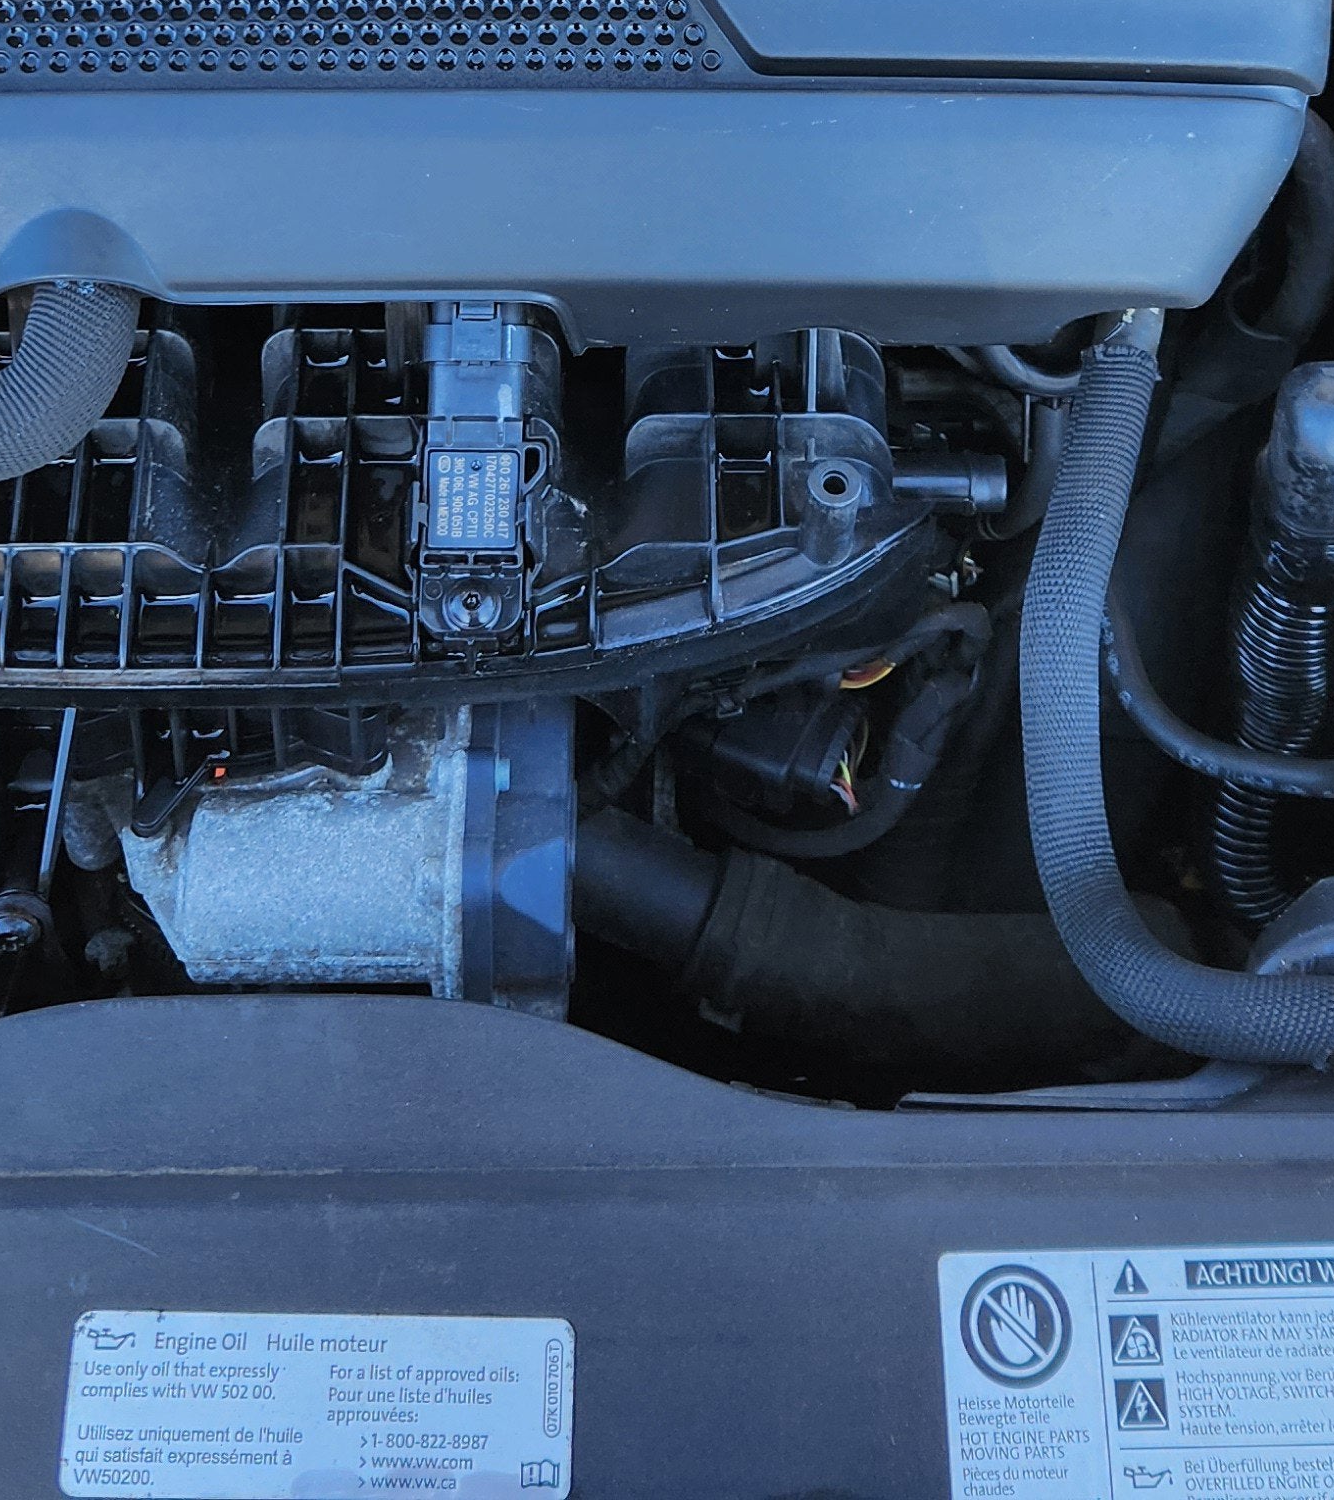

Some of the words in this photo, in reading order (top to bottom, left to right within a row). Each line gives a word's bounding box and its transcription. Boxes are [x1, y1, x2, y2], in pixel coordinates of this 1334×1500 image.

[438, 477, 450, 497] Made
[468, 473, 479, 488] VW
[499, 477, 511, 494] 261
[452, 495, 464, 513] 906
[467, 491, 479, 506] AG
[498, 497, 510, 518] 230
[437, 506, 449, 536] MEXICO
[497, 521, 509, 539] 417
[1196, 1262, 1312, 1287] ACHTUNG!
[1169, 1309, 1276, 1330] Kühlerventilator
[1278, 1309, 1313, 1328] kann
[153, 1330, 217, 1355] Engine
[221, 1331, 247, 1351] Oil
[266, 1332, 315, 1352] Huile
[319, 1333, 389, 1353] moteur
[1171, 1326, 1239, 1343] RADIATOR
[1240, 1325, 1269, 1342] FAN
[1271, 1324, 1302, 1341] MAY
[549, 1345, 560, 1353] T
[1172, 1345, 1188, 1360] Le
[1190, 1343, 1262, 1360] ventilateur
[1264, 1342, 1283, 1359] de
[83, 1360, 112, 1376] Use
[112, 1361, 149, 1382] only
[150, 1361, 170, 1377] oil
[172, 1361, 206, 1378] that
[208, 1361, 280, 1384] expressly
[329, 1363, 354, 1380] For
[355, 1367, 366, 1380] a
[369, 1363, 393, 1381] list
[395, 1364, 414, 1381] of
[414, 1364, 486, 1386] approved
[488, 1365, 520, 1383] oils:
[549, 1355, 560, 1378] 706
[1175, 1366, 1280, 1389] Hochspannung,
[1281, 1368, 1302, 1382] vor
[79, 1380, 149, 1402] complies
[151, 1381, 187, 1399] with
[190, 1382, 219, 1399] VW
[220, 1383, 249, 1400] 502
[251, 1383, 276, 1400] 00.
[328, 1386, 364, 1403] Pour
[366, 1389, 396, 1403] une
[398, 1386, 431, 1404] liste
[433, 1387, 493, 1405] d'huiles
[548, 1382, 559, 1405] 010
[1176, 1386, 1213, 1402] HIGH
[1215, 1384, 1280, 1403] VOLTAGE,
[957, 1395, 1001, 1411] Heisse
[1003, 1393, 1075, 1411] Motorteile
[1178, 1403, 1236, 1419] SYSTEM.
[326, 1405, 419, 1427] approuvées:
[547, 1407, 558, 1432] 07K
[958, 1410, 1017, 1428] Bewegte
[1019, 1408, 1050, 1425] Teile
[76, 1424, 134, 1442] Utilisez
[137, 1424, 231, 1447] uniquement
[232, 1425, 254, 1443] de
[258, 1426, 303, 1444] l'huile
[959, 1430, 989, 1446] HOT
[992, 1429, 1045, 1446] ENGINE
[1049, 1428, 1090, 1444] PARTS
[1179, 1420, 1222, 1437] Haute
[1223, 1419, 1279, 1437] tension,
[1280, 1418, 1325, 1435] arrêter
[371, 1432, 489, 1450] 1-800-822-8987
[74, 1446, 99, 1467] qui
[102, 1446, 164, 1464] satisfait
[166, 1447, 278, 1469] expressément
[281, 1448, 293, 1466] à
[960, 1445, 1020, 1461] MOVING
[1023, 1444, 1065, 1460] PARTS
[370, 1455, 473, 1471] www.vw.com
[1183, 1458, 1205, 1474] Bei
[1207, 1454, 1290, 1475] Überfüllung
[72, 1468, 154, 1486] VW50200.
[962, 1465, 1001, 1482] Pièces
[1002, 1464, 1020, 1481] du
[1021, 1465, 1069, 1480] moteur
[1184, 1475, 1265, 1491] OVERFILLED
[1267, 1472, 1321, 1490] ENGINE
[369, 1476, 457, 1490] www.vw.ca
[963, 1480, 1016, 1497] chaudes
